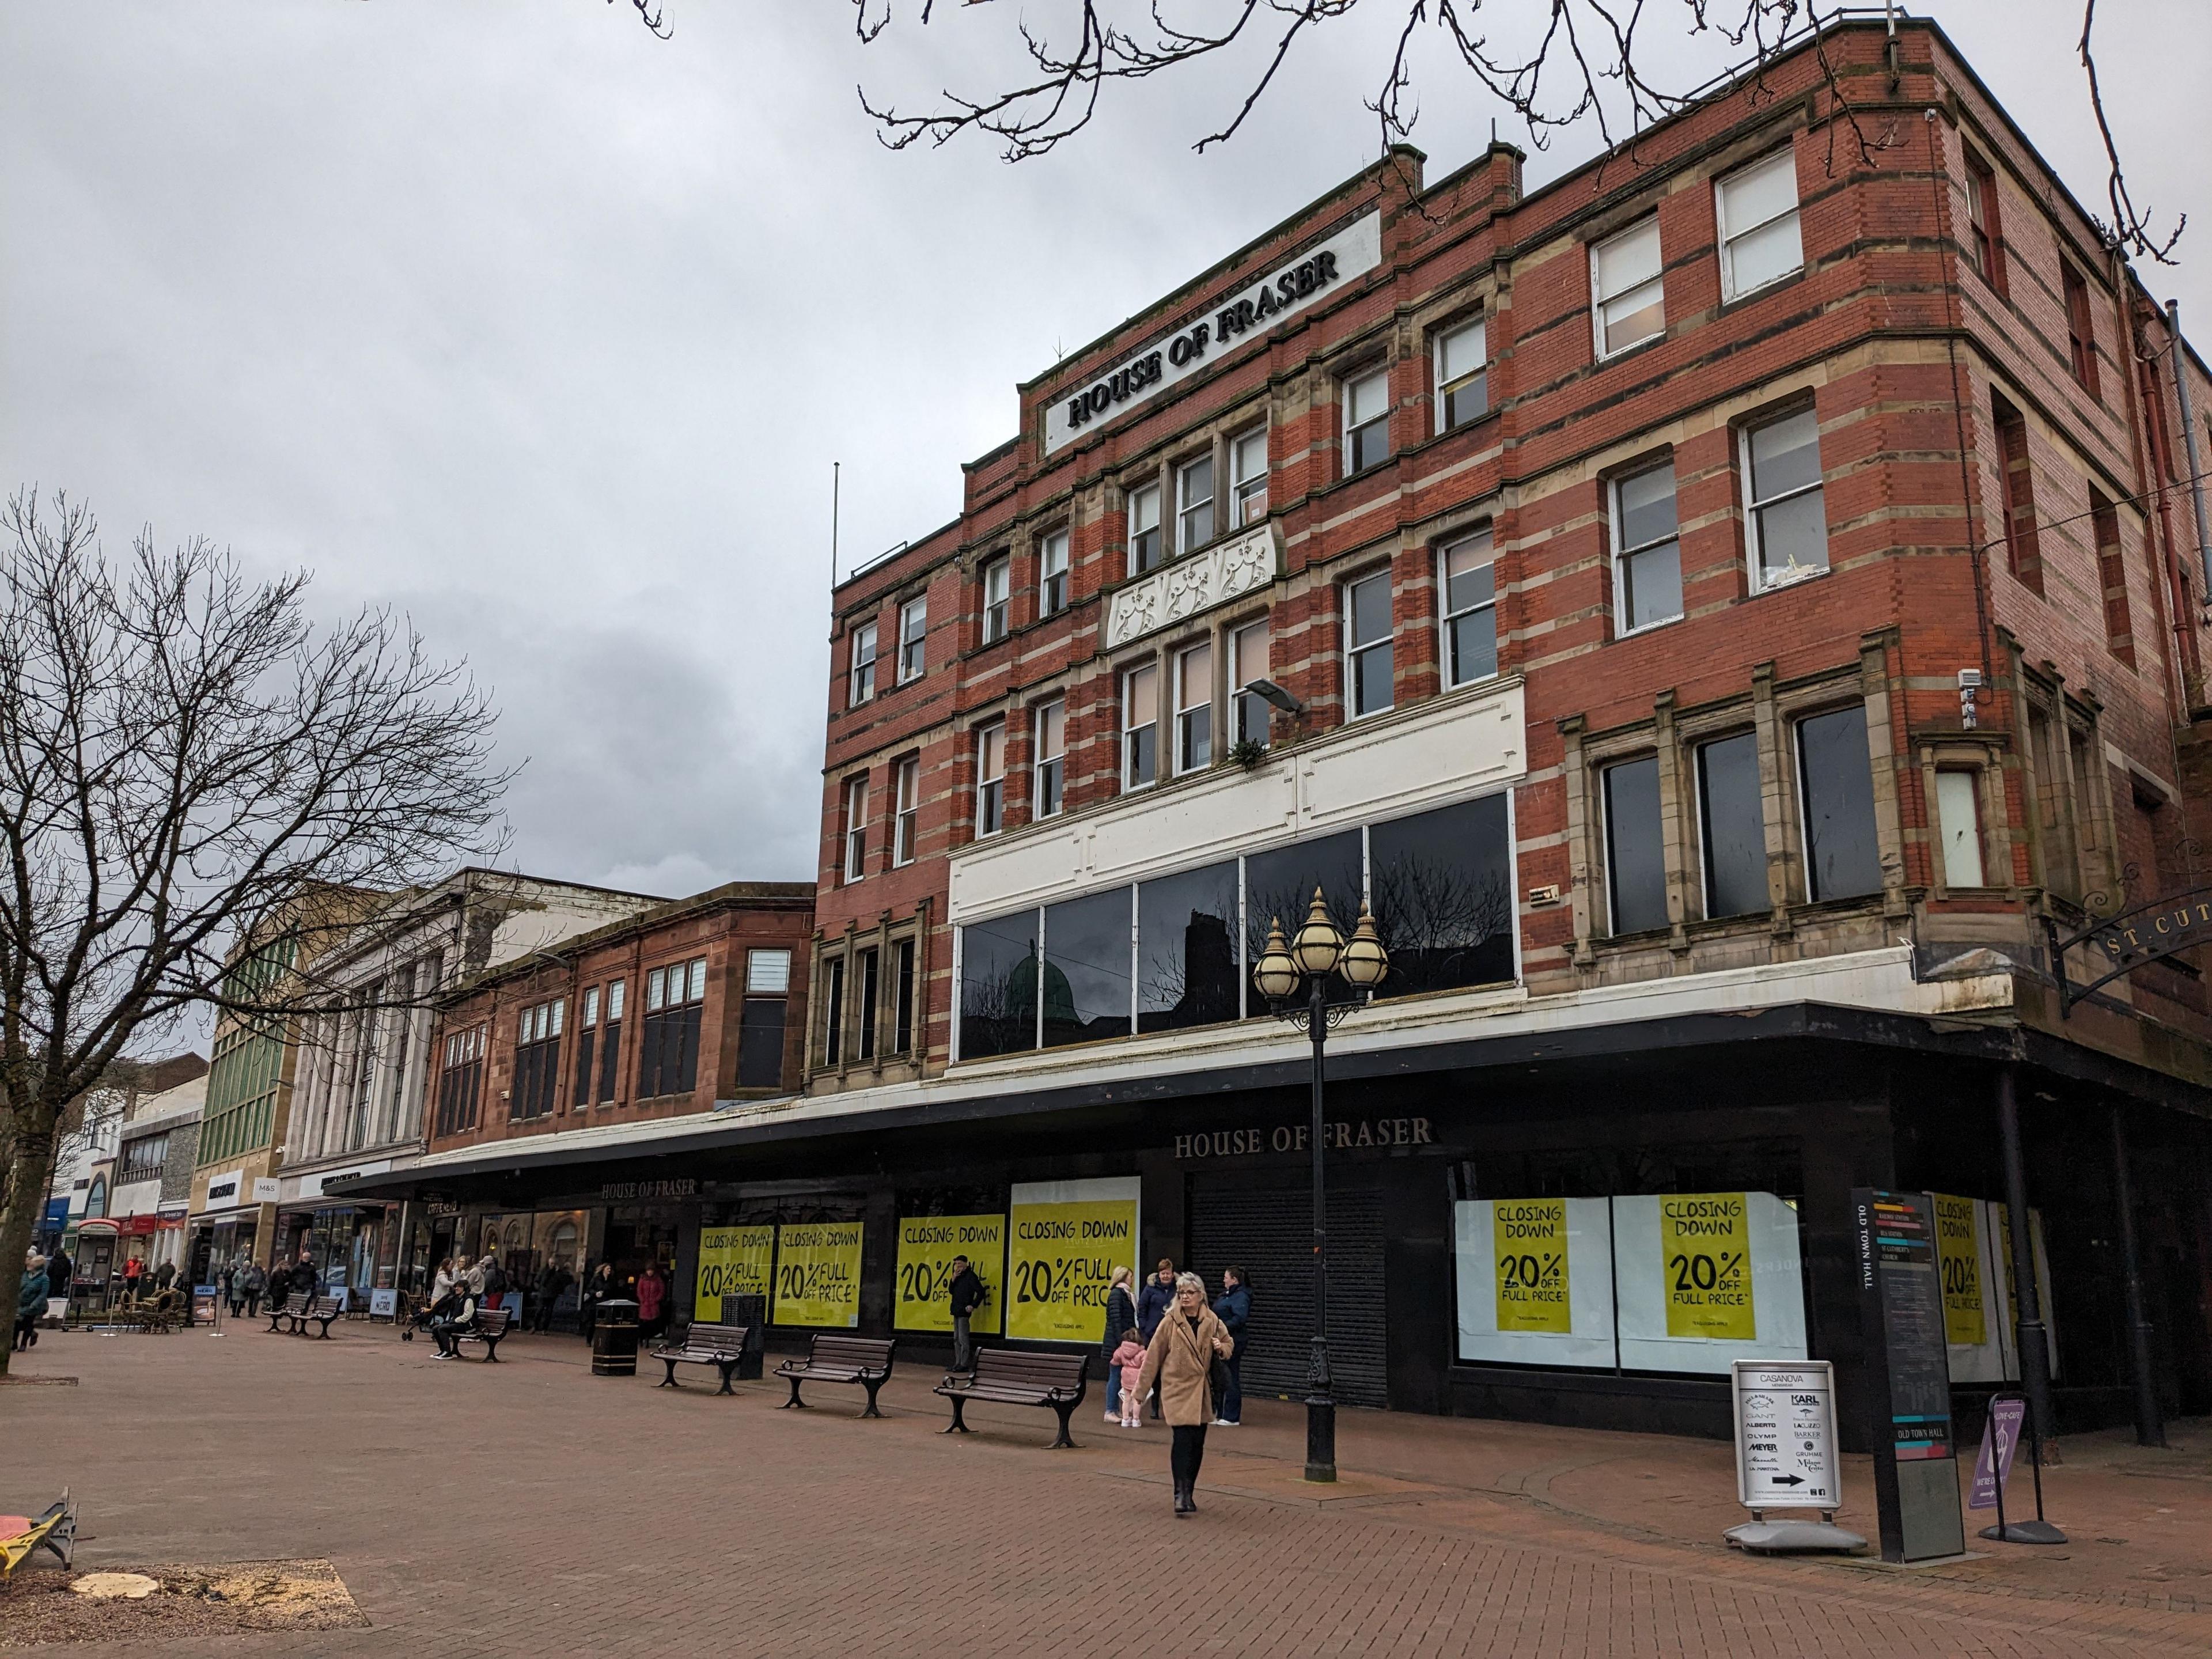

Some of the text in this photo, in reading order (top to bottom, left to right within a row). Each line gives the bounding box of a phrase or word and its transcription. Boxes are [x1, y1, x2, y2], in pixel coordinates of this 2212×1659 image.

[1067, 251, 1339, 428] HOUSE OF FRASER
[1175, 1118, 1432, 1158] HOUSE OF FRASER
[601, 1179, 695, 1199] HOUSE OF FRASER
[1498, 1206, 1562, 1222] CLOSING
[1665, 1200, 1741, 1218] CLOSING
[1937, 1201, 1972, 1221] CLOSING
[905, 1226, 998, 1244] CLOSING DOWN
[1018, 1219, 1128, 1240] CLOSING DOWN
[1506, 1224, 1554, 1238] DOWN
[1676, 1219, 1733, 1236] DOWN
[1942, 1221, 1969, 1238] DOWN
[705, 1233, 770, 1249] CLOSING DOWN
[784, 1230, 858, 1247] CLOSING DOWN
[1858, 1205, 1873, 1290] OLD TOWN HALL
[1500, 1252, 1562, 1288] 20%
[1669, 1252, 1742, 1291] 20%
[1942, 1256, 1975, 1294] 20%
[701, 1263, 760, 1297] 20% FULL
[781, 1262, 849, 1300] 20% FULL
[901, 1260, 951, 1302] 20%
[1015, 1257, 1073, 1303] 20%
[1074, 1258, 1112, 1281] FULL
[1541, 1278, 1560, 1289] OFF
[1718, 1280, 1741, 1291] OFF
[804, 1289, 816, 1300] OFF
[933, 1290, 949, 1302] OFF
[1051, 1285, 1109, 1306] OFF PRIC
[1502, 1290, 1528, 1301] FULL
[1673, 1293, 1704, 1305] FULL
[1965, 1285, 1976, 1296] OFF
[1760, 1374, 1804, 1382] CASANOVA
[1791, 1395, 1819, 1403] KARL
[1898, 1428, 1944, 1439] OLD TOWN HALL
